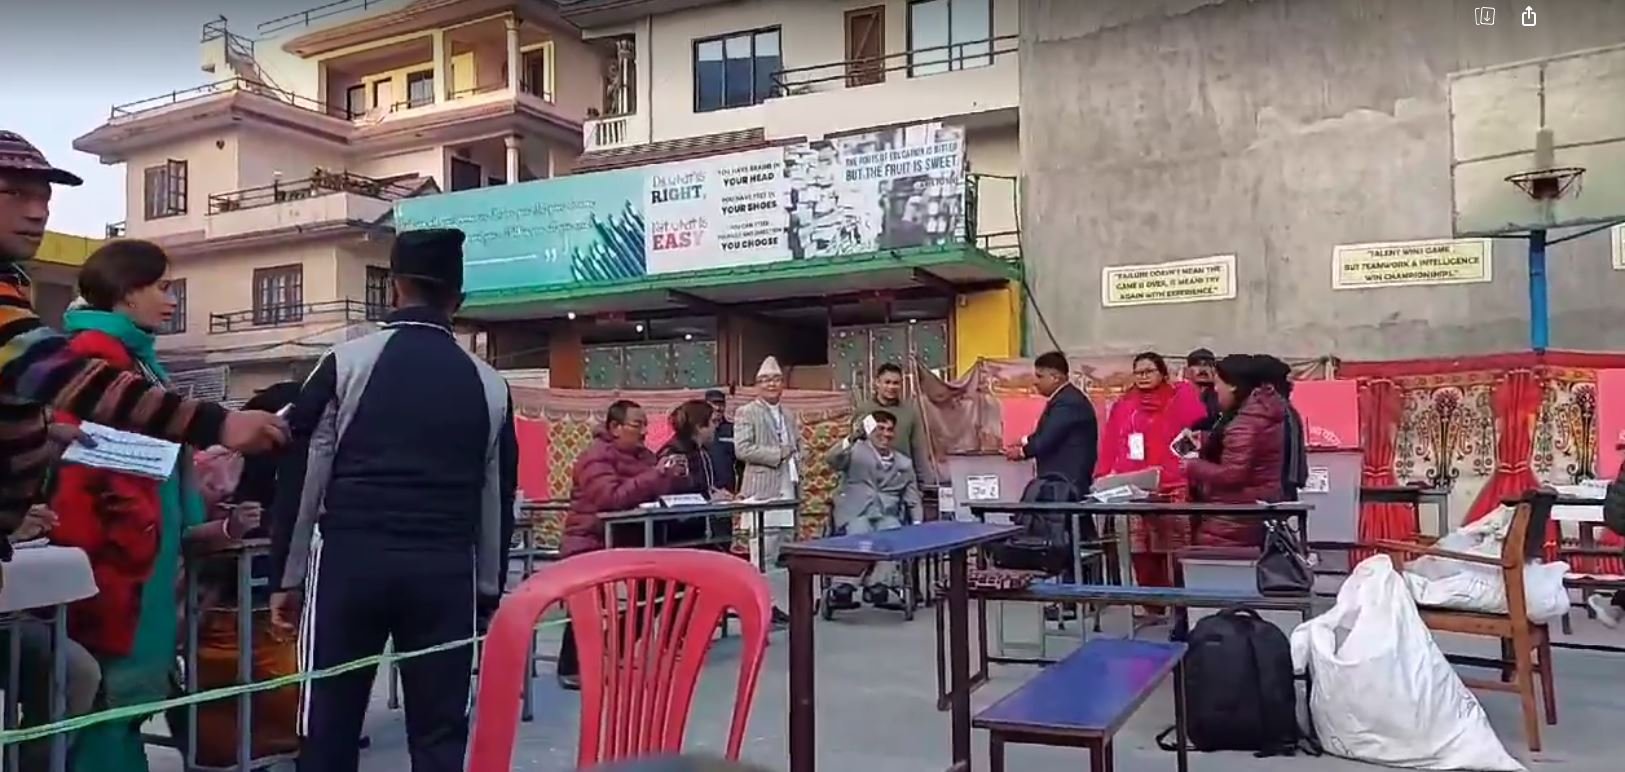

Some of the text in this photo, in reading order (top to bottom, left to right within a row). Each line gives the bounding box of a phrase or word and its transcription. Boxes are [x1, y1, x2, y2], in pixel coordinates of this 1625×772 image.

[846, 169, 861, 181] BUT
[866, 166, 882, 179] THE
[884, 161, 911, 177] FRUIT
[913, 160, 923, 172] IS
[723, 172, 775, 187] YOUR HEAD
[651, 184, 707, 205] RIGHT,
[722, 200, 777, 216] YOUR SHOES
[652, 230, 705, 250] EASY
[721, 236, 778, 252] YOU CHOOSE
[1182, 267, 1205, 275] MEAN
[1344, 262, 1359, 271] BUT
[1361, 260, 1409, 270] TEAMWORK
[1420, 256, 1480, 266] INTELLIGENCE
[1364, 273, 1383, 281] WIN
[1115, 282, 1137, 290] GAME
[1120, 292, 1144, 300] AGAIN
